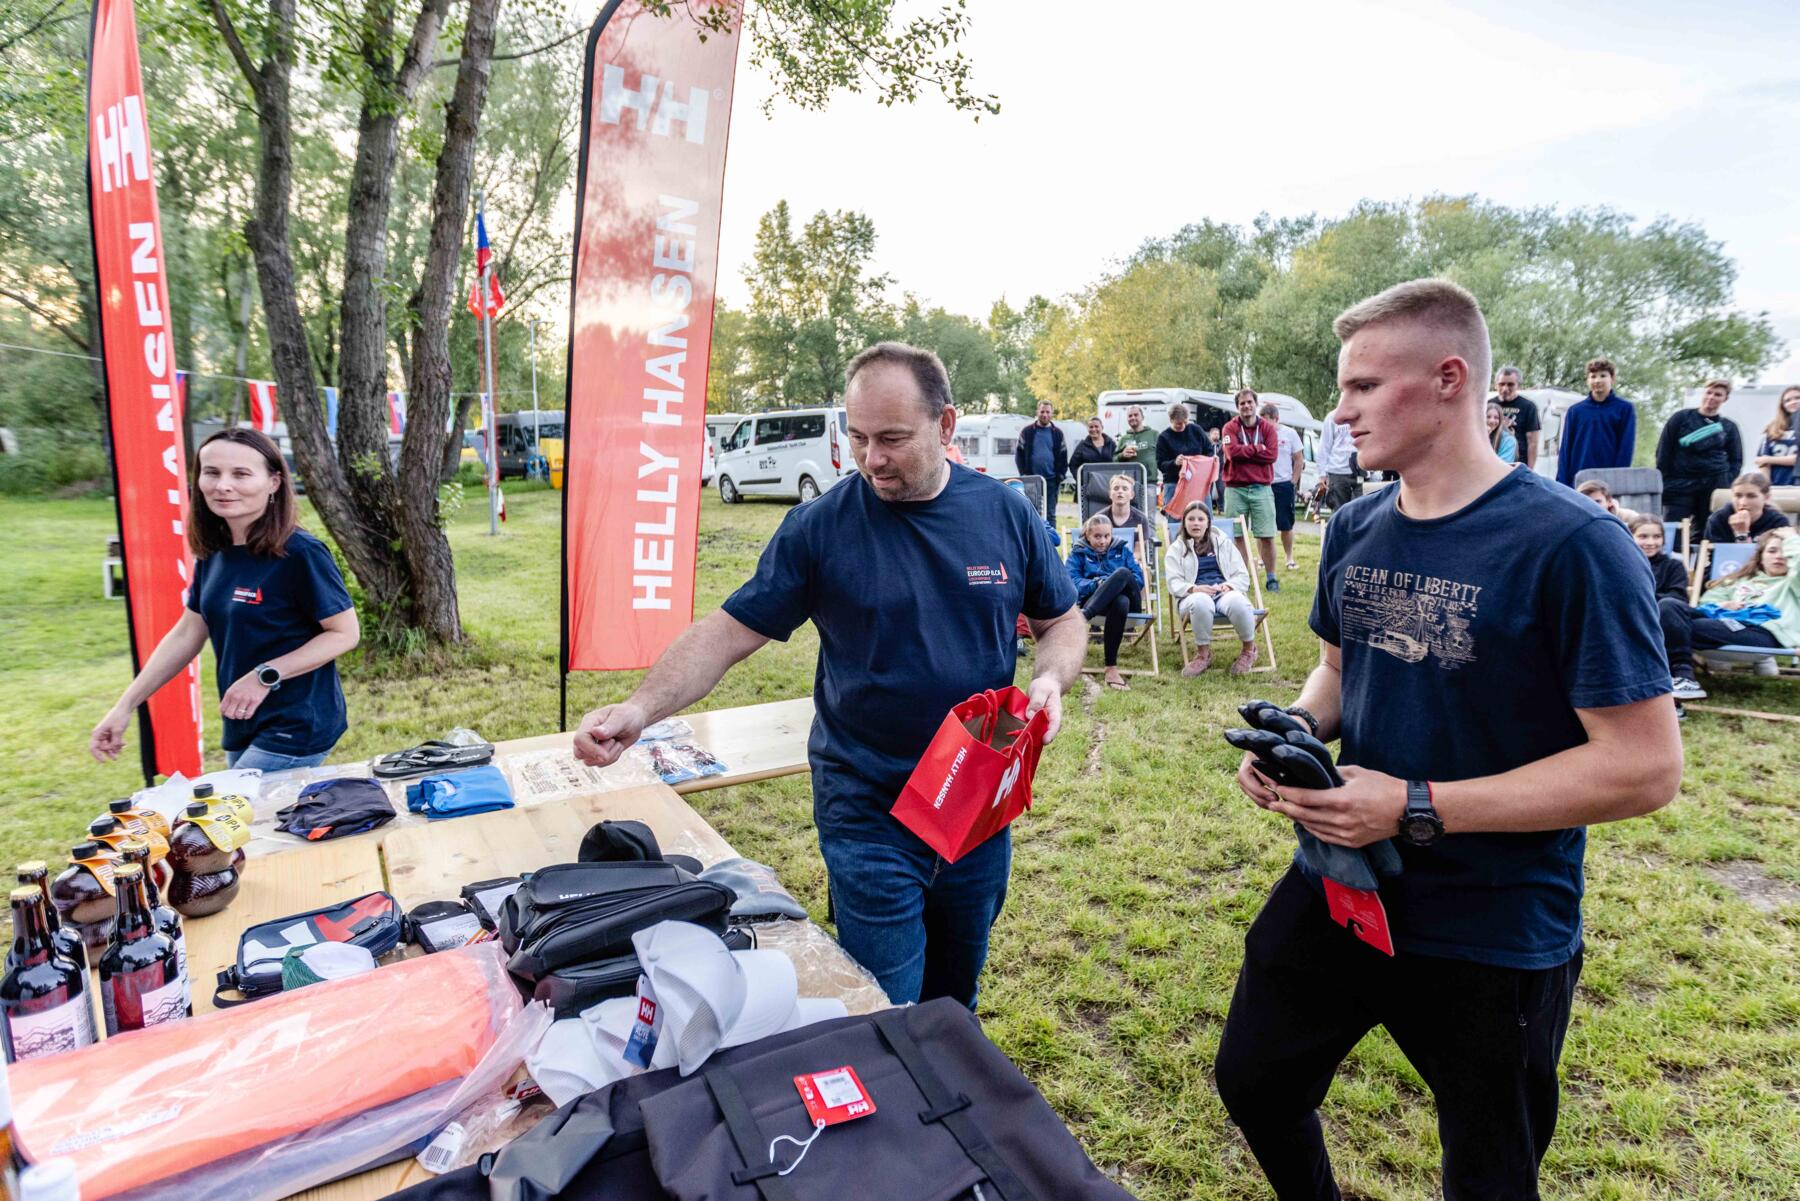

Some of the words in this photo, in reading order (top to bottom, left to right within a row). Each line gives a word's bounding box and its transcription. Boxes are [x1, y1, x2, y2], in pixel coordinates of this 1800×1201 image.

[600, 63, 709, 145] HH
[97, 95, 149, 192] HH
[641, 193, 700, 426] HANSEN
[633, 441, 680, 610] HELLY
[1344, 565, 1389, 585] OCEAN
[1394, 571, 1414, 589] OF
[1414, 574, 1483, 604] LIBERTY
[951, 746, 967, 775] HELLY
[232, 798, 246, 810] IPA
[933, 773, 953, 809] HANSEN
[225, 818, 241, 831] IPA
